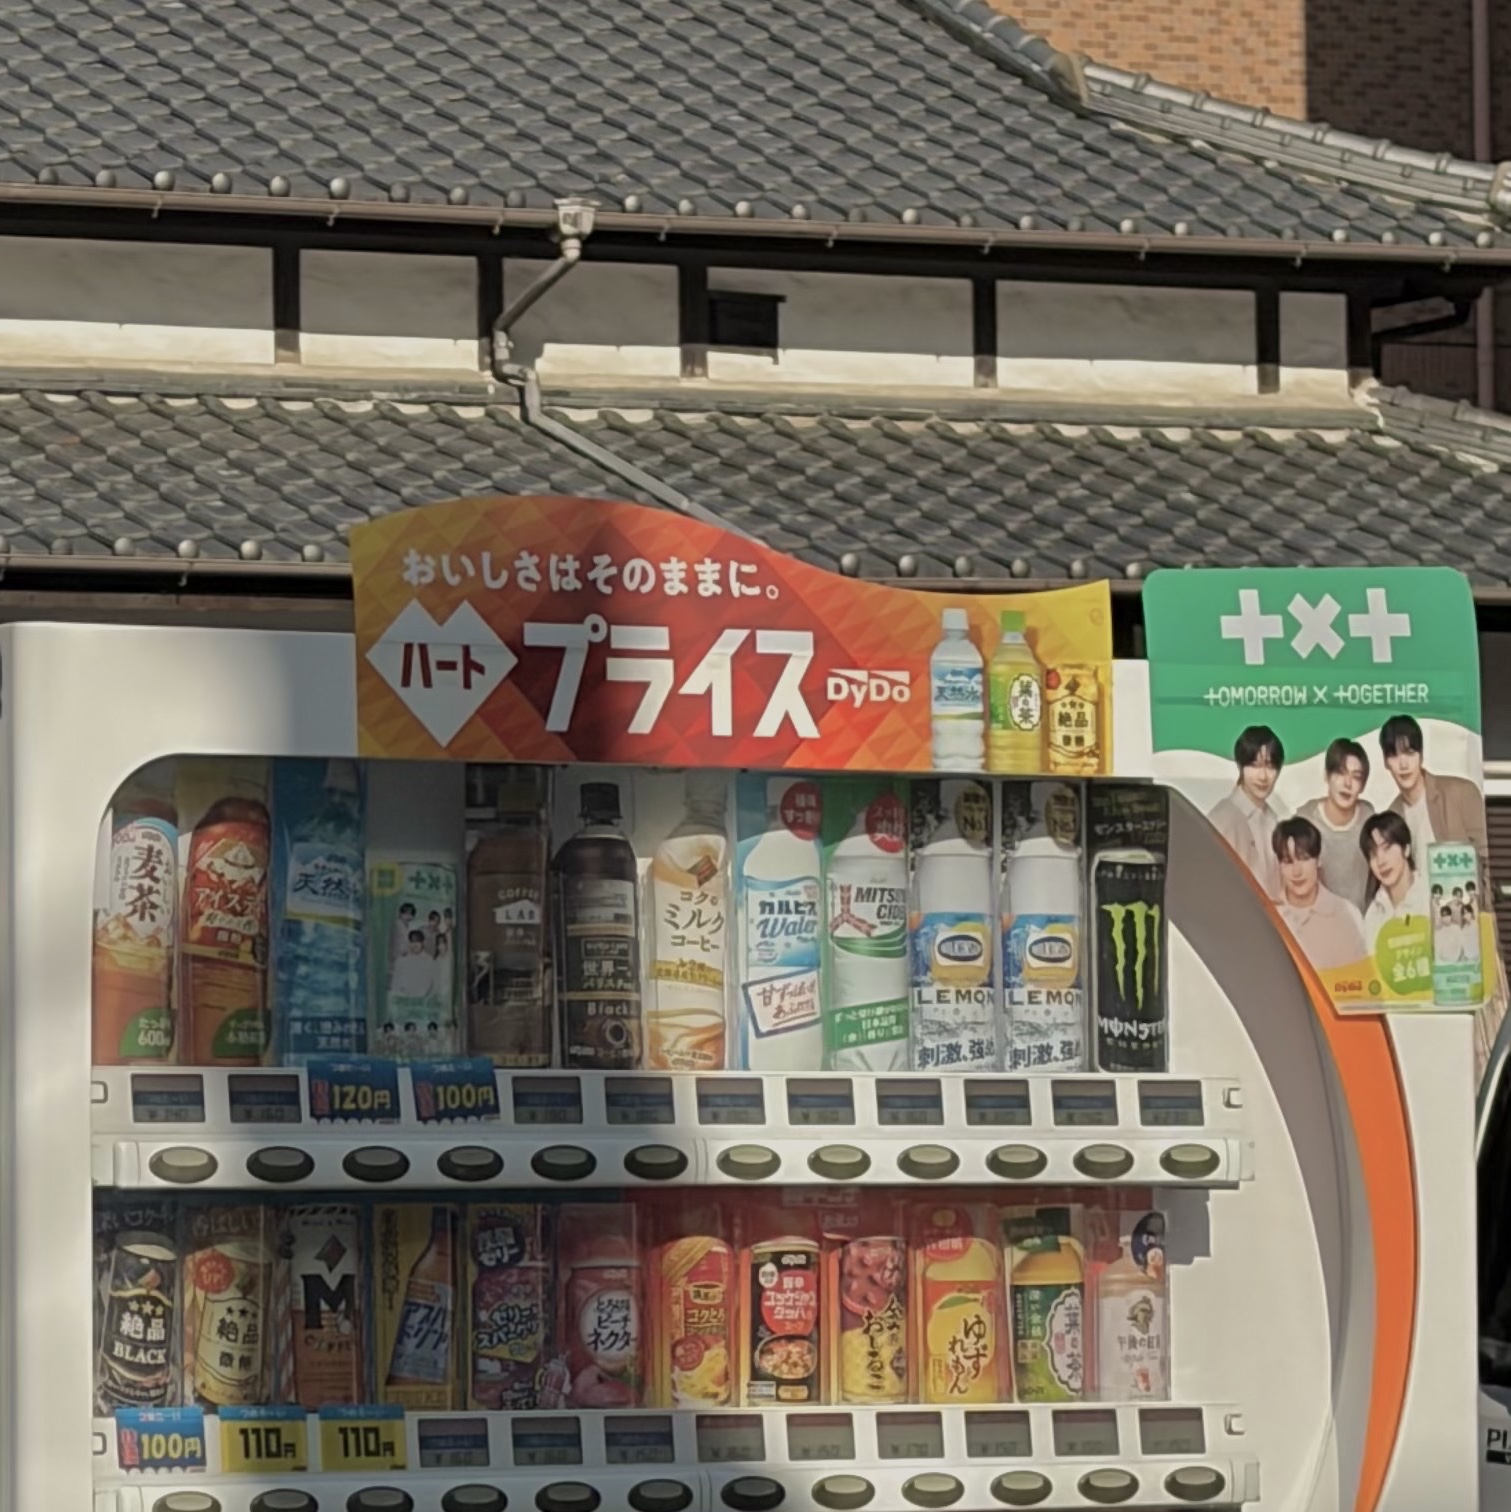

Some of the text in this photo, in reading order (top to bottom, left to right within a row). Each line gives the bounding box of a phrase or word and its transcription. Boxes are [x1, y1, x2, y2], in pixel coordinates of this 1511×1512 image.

[403, 547, 780, 600] おいしさはそのままに。
[400, 614, 821, 738] ハート プライス
[826, 668, 911, 708] DyDo
[124, 844, 163, 922] 麦茶
[663, 903, 724, 935] ミルク
[671, 935, 720, 952] コーヒー
[332, 1085, 391, 1111] 120円
[435, 1083, 496, 1111] 100円
[119, 1311, 165, 1341] 絶品
[217, 1318, 259, 1345] 絶品
[112, 1340, 167, 1365] BLACK
[862, 1310, 885, 1391] おしるこ
[963, 1314, 988, 1380] ゆず
[949, 1336, 968, 1395] れもん
[141, 1433, 202, 1458] 100円
[239, 1427, 296, 1459] 110円
[338, 1426, 395, 1458] 110円
[1487, 1428, 1511, 1450] PI
